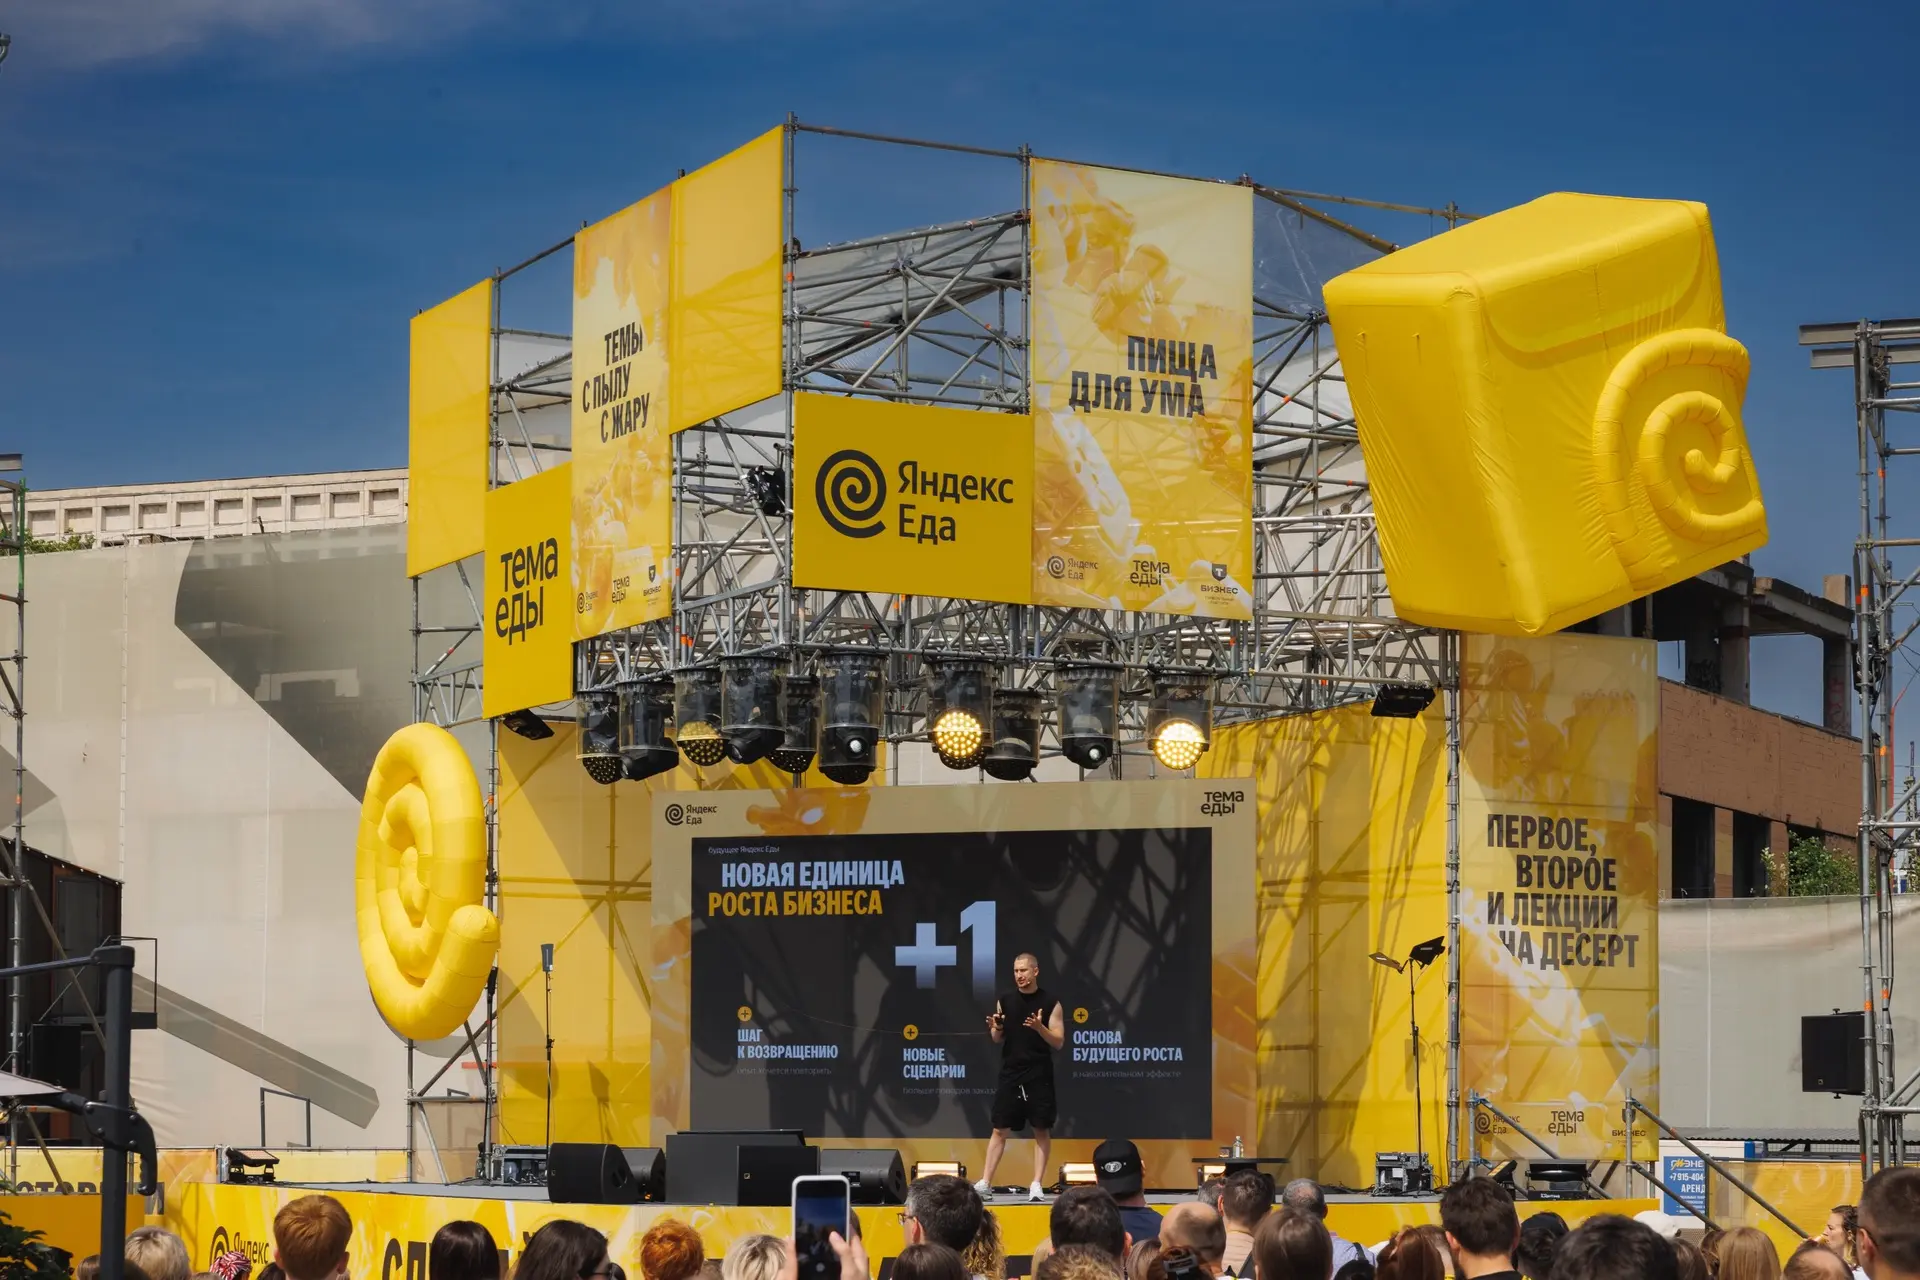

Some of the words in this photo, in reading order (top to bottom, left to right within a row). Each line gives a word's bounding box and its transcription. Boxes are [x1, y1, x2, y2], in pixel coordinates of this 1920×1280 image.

[604, 321, 643, 367] ТЕМЫ
[1127, 335, 1217, 382] ПИЩА
[582, 380, 590, 413] С
[593, 362, 631, 409] ПЫЛУ
[1069, 371, 1132, 413] ДЛЯ
[1140, 377, 1205, 418] УМА
[601, 409, 608, 443] С
[611, 392, 650, 440] ЖАРУ
[898, 460, 1014, 504] Яндекс
[898, 503, 956, 545] Еда
[501, 537, 558, 592] тема
[1067, 560, 1098, 571] Яндекс
[1133, 558, 1170, 575] тема
[1067, 570, 1084, 580] Еда
[1130, 571, 1162, 588] еды
[613, 575, 630, 592] тема
[1200, 584, 1239, 594] БИЗНЕС
[612, 589, 626, 604] еды
[495, 585, 544, 645] еды
[1204, 790, 1244, 802] тема
[686, 804, 718, 815] Яндекс
[1200, 803, 1235, 817] еды
[686, 815, 702, 825] Еда
[1487, 814, 1598, 857] ПЕРВОЕ,
[740, 845, 764, 855] Яндекс
[765, 845, 780, 854] Еды
[722, 862, 795, 888] НОВАЯ
[800, 860, 905, 890] ЕДИНИЦА
[1516, 854, 1617, 892] ВТОРОЕ
[708, 891, 779, 917] РОСТА
[784, 890, 883, 916] БИЗНЕСА
[1487, 892, 1504, 926] И
[1511, 893, 1618, 930] ЛЕКЦИИ
[1498, 930, 1534, 965] НА
[1540, 932, 1639, 971] ДЕСЕРТ
[737, 1029, 763, 1042] ШАГ
[1073, 1030, 1122, 1044] ОСНОВА
[737, 1045, 745, 1058] К
[747, 1045, 839, 1060] ВОЗВРАЩЕНИЮ
[903, 1048, 945, 1061] НОВЫЕ
[1073, 1047, 1141, 1063] БУДУЩЕГО
[1143, 1047, 1183, 1061] РОСТА
[903, 1064, 966, 1080] СЦЕНАРИИ
[1551, 1110, 1585, 1122] тема
[1492, 1124, 1507, 1135] Еда
[1548, 1122, 1577, 1137] еды
